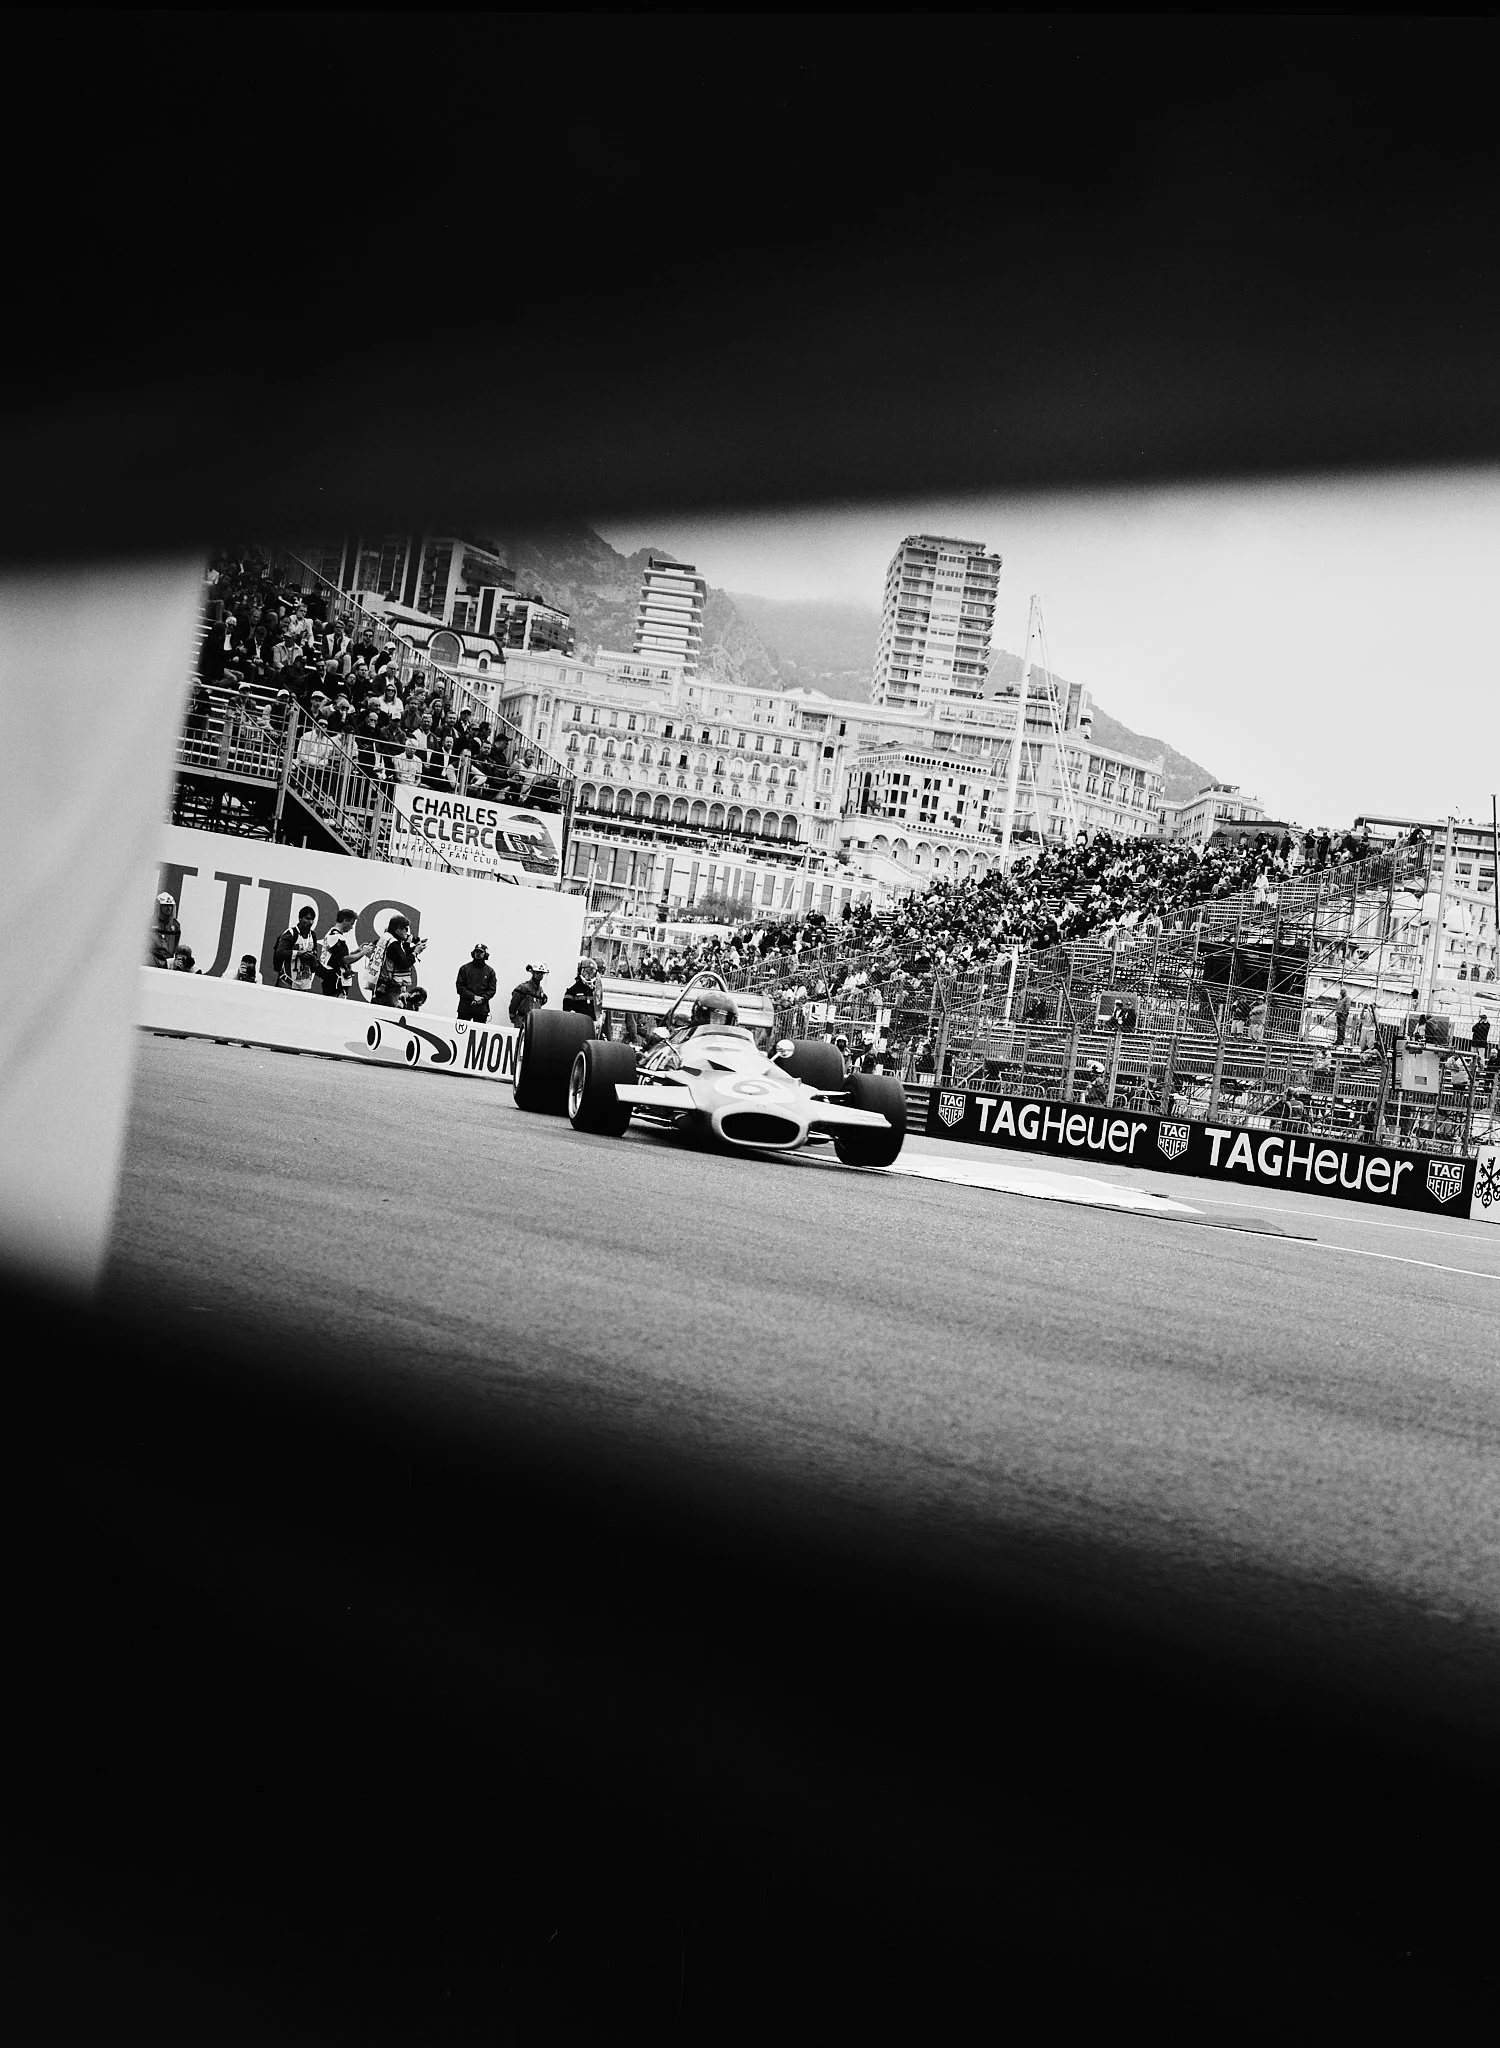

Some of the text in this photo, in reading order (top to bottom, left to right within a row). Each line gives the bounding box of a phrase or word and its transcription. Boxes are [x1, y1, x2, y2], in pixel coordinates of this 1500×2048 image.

[412, 796, 498, 827] CHARLES
[396, 812, 494, 849] LECLERC
[440, 842, 486, 856] OFFICIAL
[449, 851, 468, 861] FAN
[473, 855, 498, 866] CLUB
[732, 1079, 781, 1096] 6
[942, 1093, 964, 1107] TAG
[940, 1106, 963, 1125] HEUER
[1162, 1124, 1188, 1139] TAG
[1159, 1138, 1188, 1158] HEUER
[1432, 1162, 1461, 1178] TAG
[1428, 1178, 1461, 1200] HEUER
